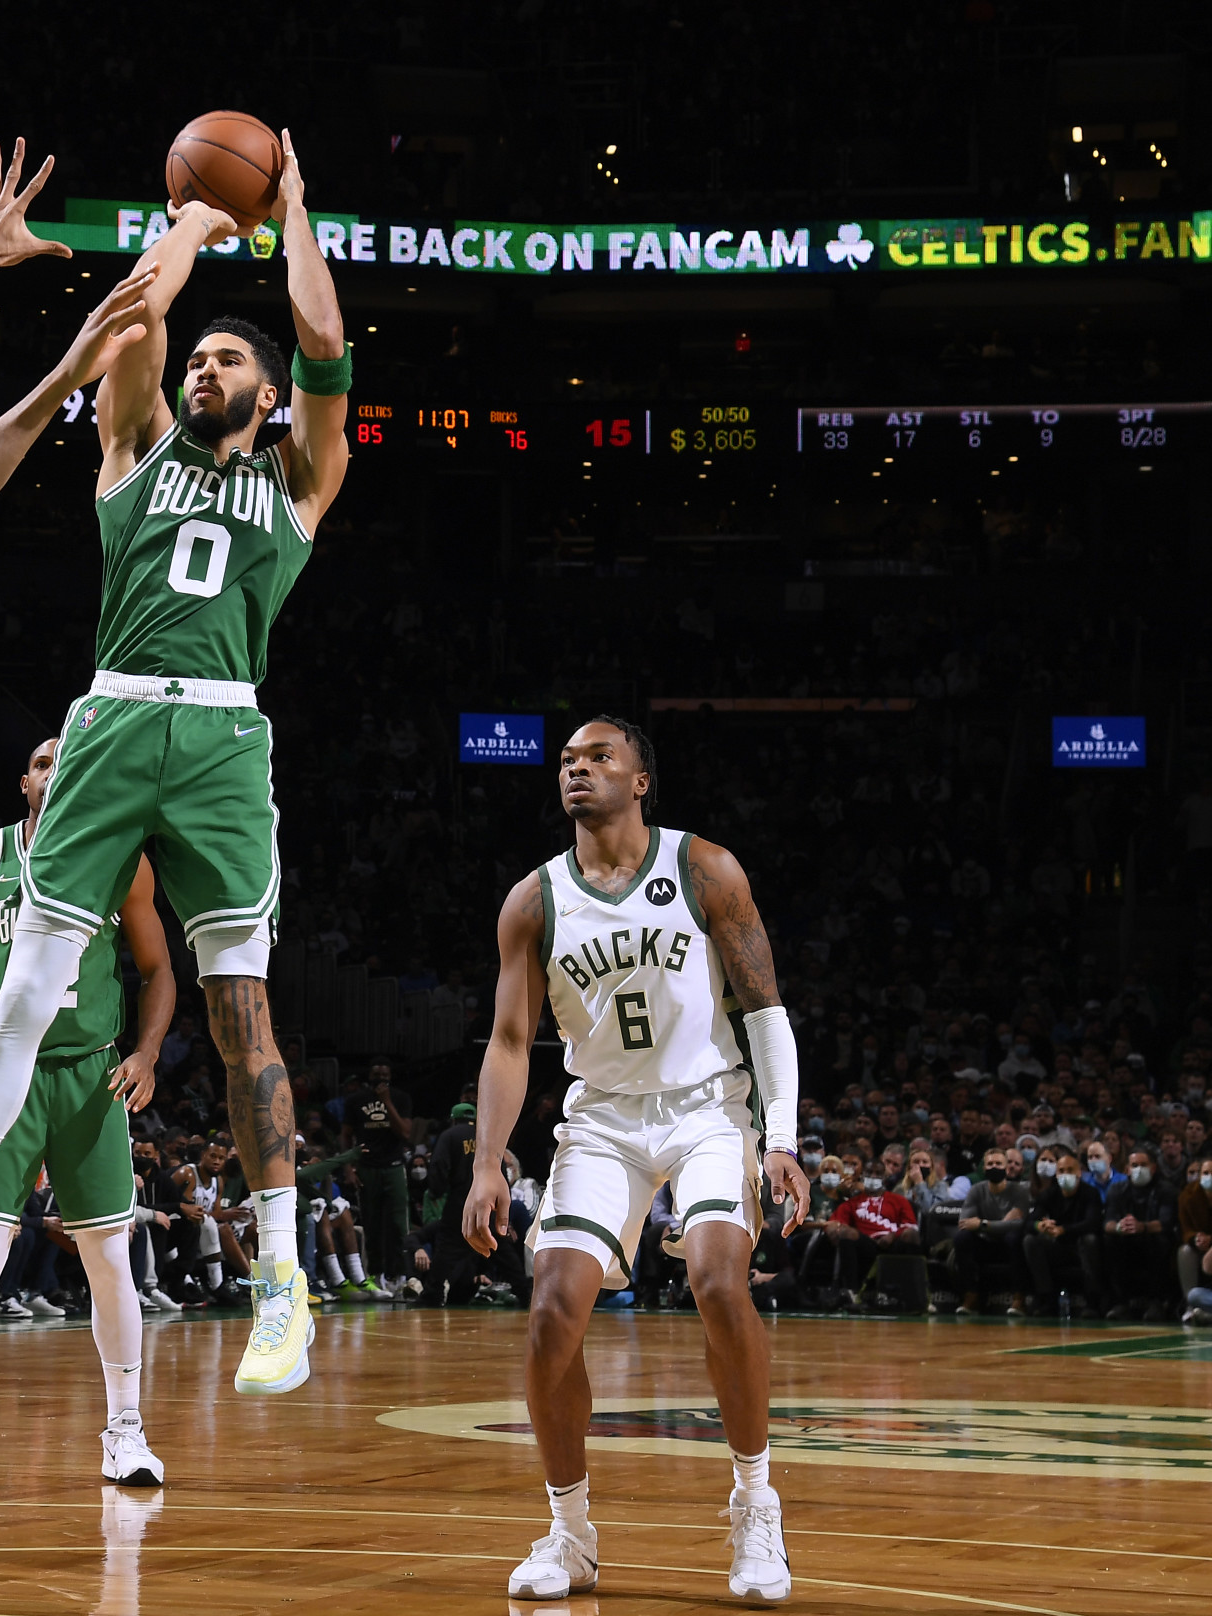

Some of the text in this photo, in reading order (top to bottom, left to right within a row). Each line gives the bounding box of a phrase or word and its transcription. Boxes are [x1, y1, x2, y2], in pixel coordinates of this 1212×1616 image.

[282, 220, 376, 262] RE
[389, 225, 516, 268] BACK
[524, 231, 595, 272] ON
[608, 229, 809, 270] FANCAM
[358, 405, 392, 418] CELTICS
[418, 409, 469, 429] 11:07
[490, 410, 518, 423] BUCKS
[701, 407, 750, 423] 50/50
[817, 408, 1155, 427] REB AST STL TO 3PT
[357, 423, 383, 444] 85
[446, 435, 457, 449] 4
[504, 430, 528, 450] 76
[585, 419, 632, 447] 15
[824, 427, 1166, 449] 33 17 6 9 8/28
[146, 460, 275, 534] BOSTON
[168, 518, 232, 599] 0
[464, 736, 538, 750] ARBELLA
[473, 749, 529, 757] INSURANCE
[1058, 739, 1140, 752] ARBELLA
[558, 926, 692, 992] BUCKS
[613, 990, 656, 1053] 6
